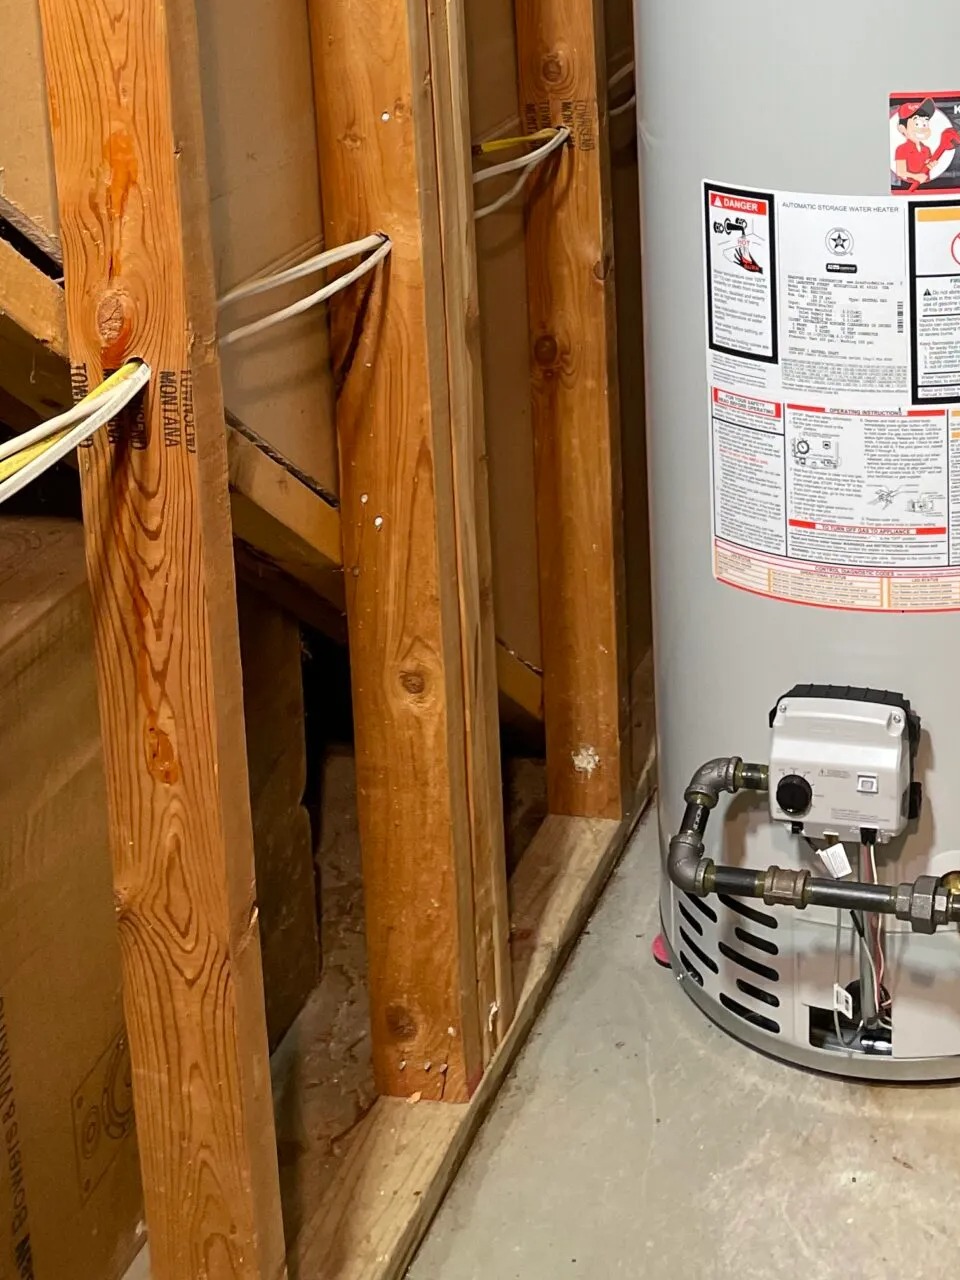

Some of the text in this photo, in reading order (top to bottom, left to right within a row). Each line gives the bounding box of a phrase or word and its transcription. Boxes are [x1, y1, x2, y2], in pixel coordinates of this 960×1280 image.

[723, 198, 758, 212] DANGER
[782, 202, 816, 210] AUTOMATIC
[160, 370, 181, 448] MONTANA
[829, 408, 860, 416] OPERATING
[815, 565, 839, 573] CONTROL
[841, 568, 874, 576] DIAGNOSTIC
